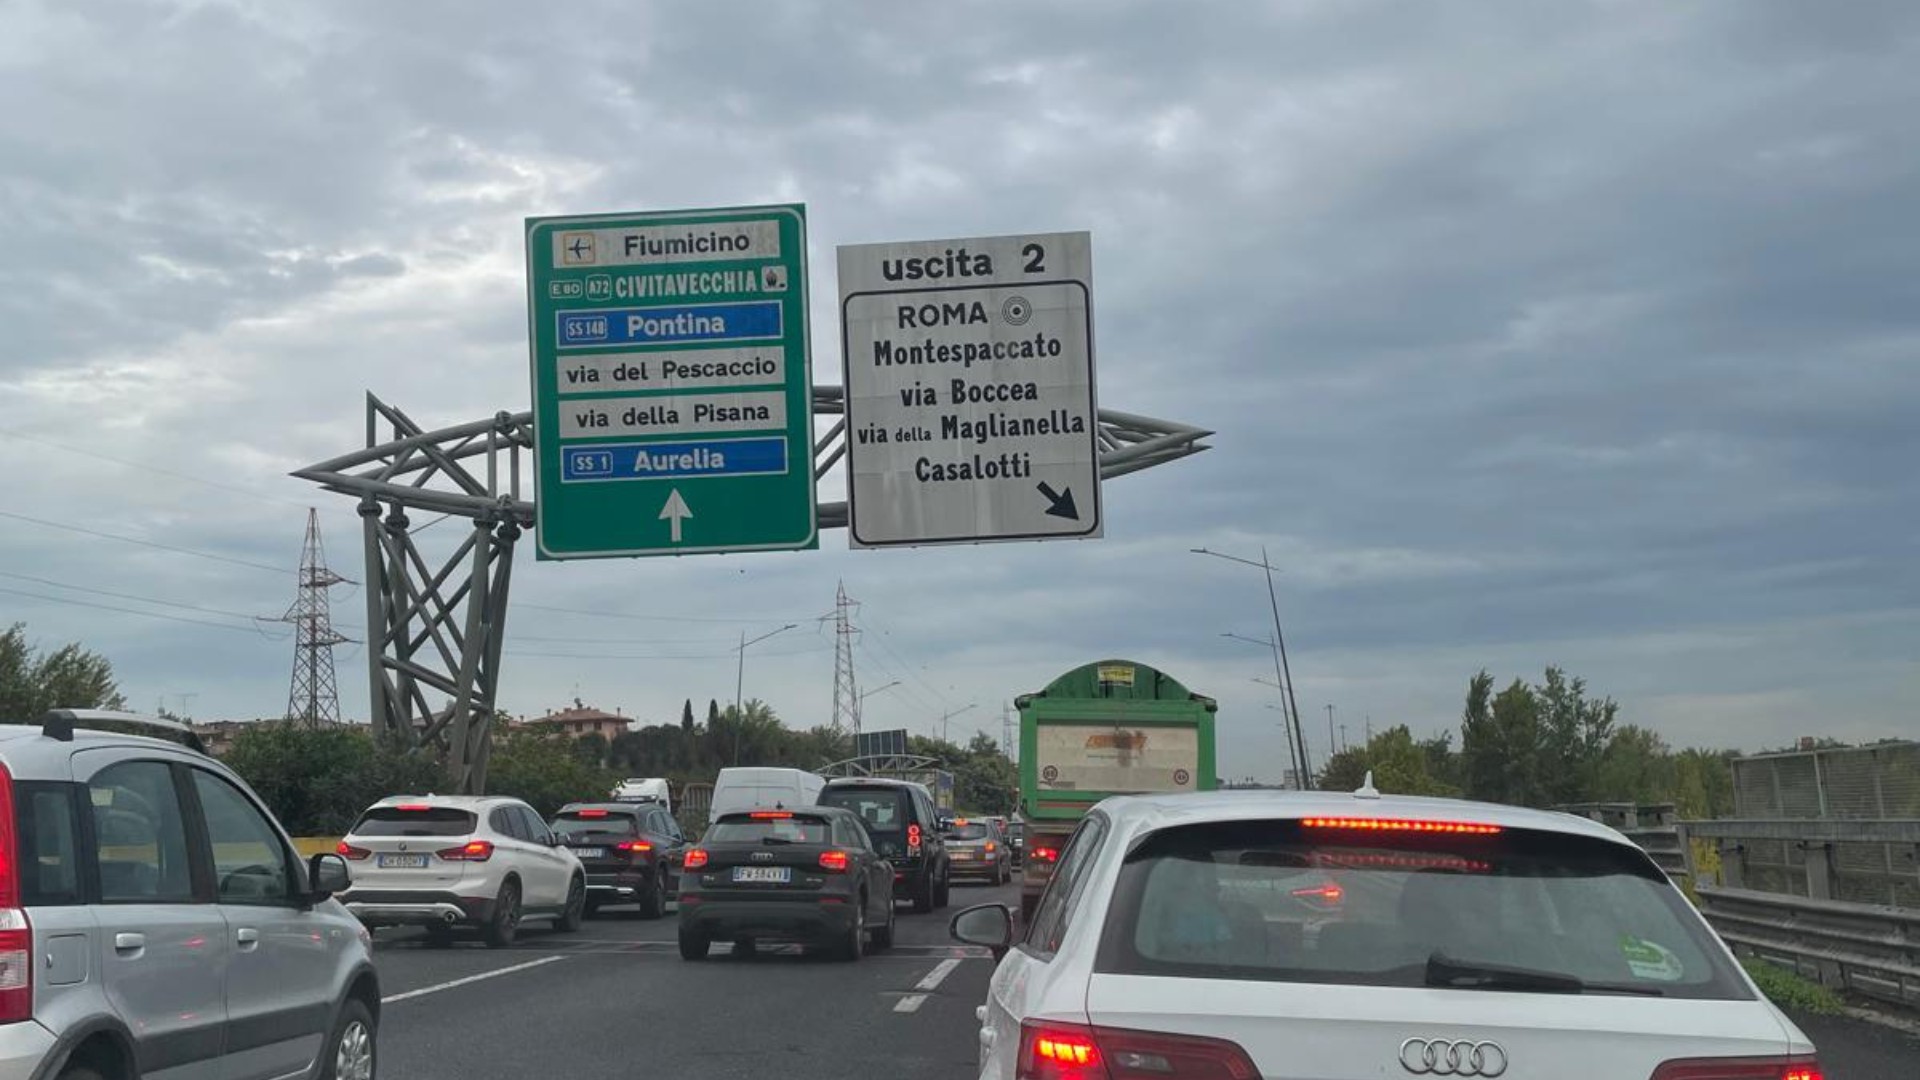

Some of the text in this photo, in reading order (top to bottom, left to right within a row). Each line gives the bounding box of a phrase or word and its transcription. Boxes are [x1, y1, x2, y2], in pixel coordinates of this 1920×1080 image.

[624, 233, 750, 257] Fiumicino
[882, 243, 1046, 281] uscita 2
[552, 283, 580, 295] E 80
[615, 271, 757, 299] CIVITAVECCHIA
[627, 314, 725, 337] Pontina
[898, 302, 988, 329] ROMA
[568, 322, 583, 336] SS
[873, 332, 1062, 368] Montespaccato
[566, 357, 776, 383] via del Pescaccio
[900, 378, 1038, 406] via Boccea
[575, 404, 770, 428] via della Pisana
[857, 409, 1085, 444] via della Maglianella
[575, 455, 608, 471] SS 1
[633, 449, 725, 472] Aurelia
[915, 453, 1031, 483] Casalotti
